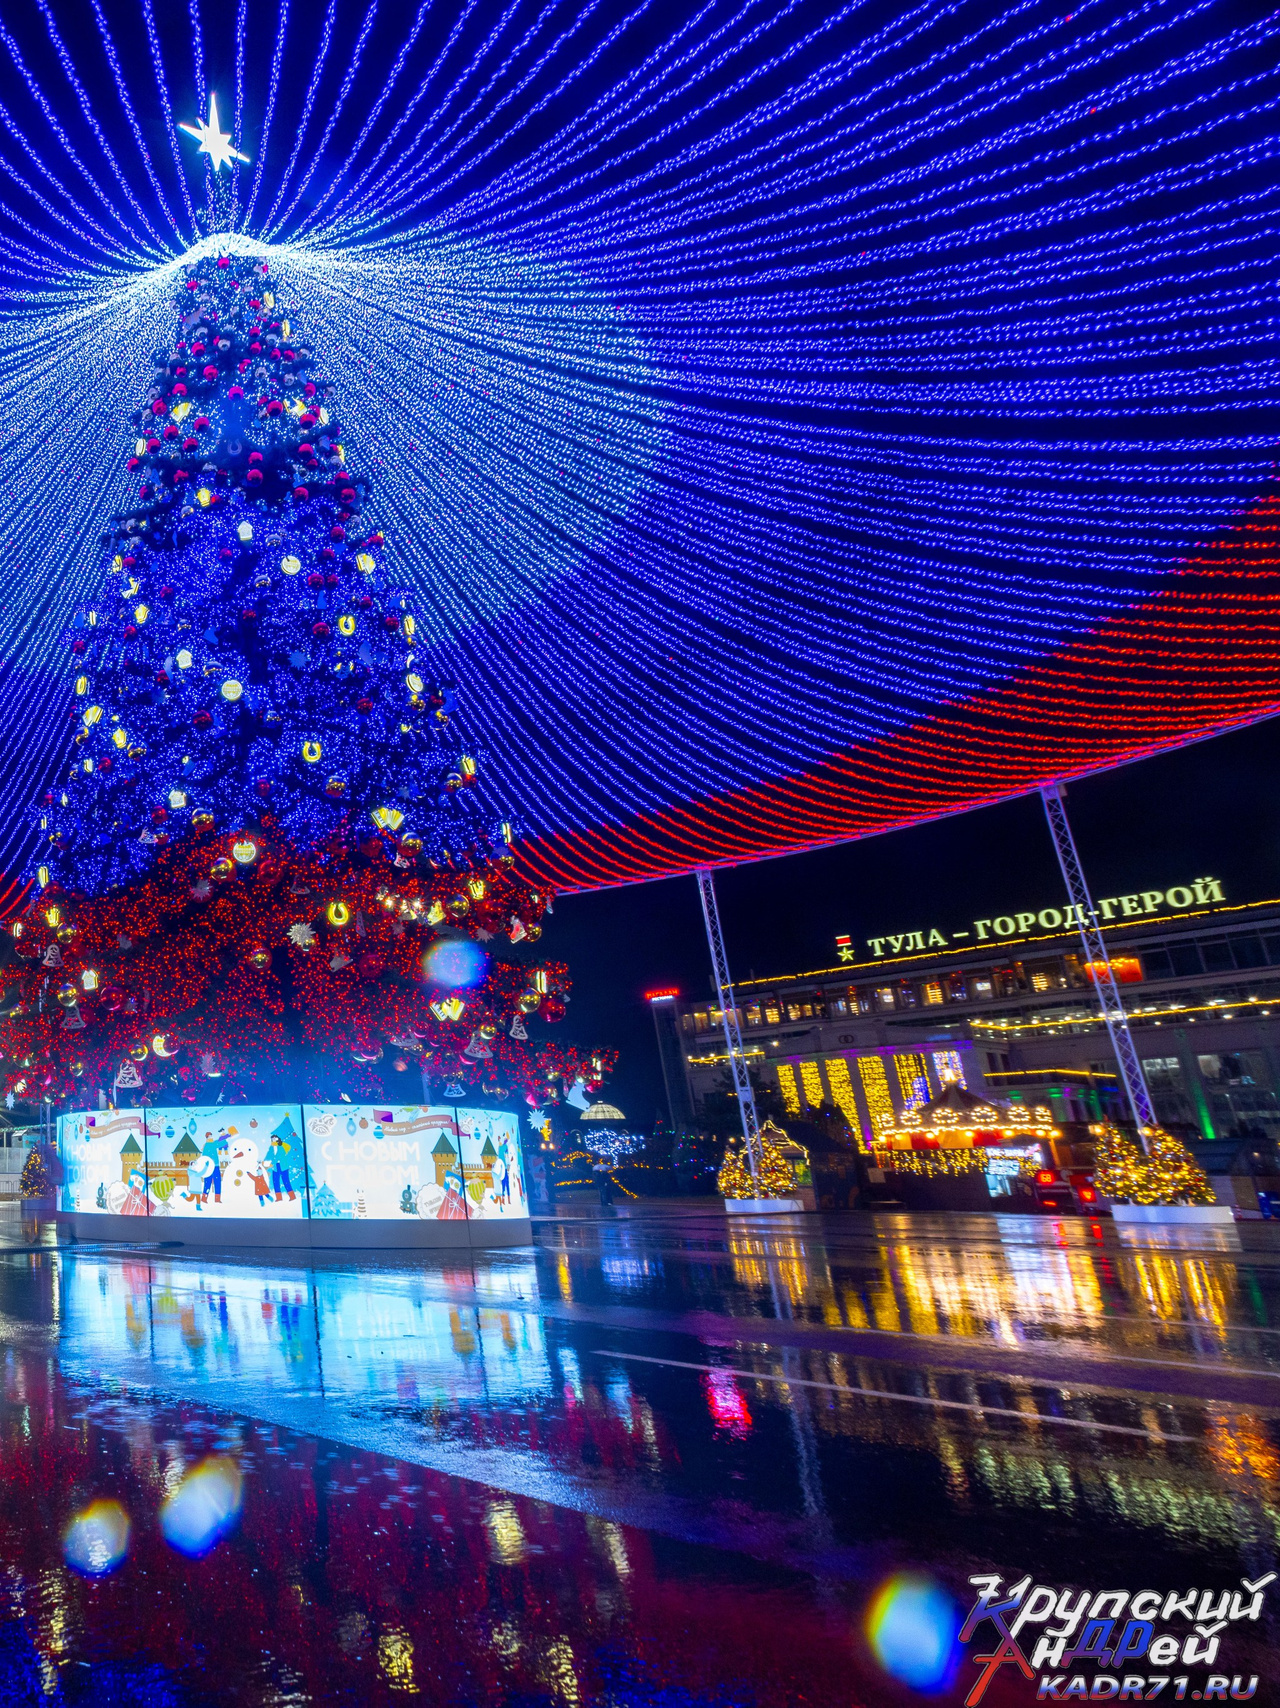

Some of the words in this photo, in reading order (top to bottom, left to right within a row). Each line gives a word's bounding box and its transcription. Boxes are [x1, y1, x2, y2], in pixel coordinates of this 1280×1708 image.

[867, 928, 949, 957] ТУЛА
[321, 1141, 333, 1161] С
[338, 1141, 421, 1162] НОВЫМ
[326, 1164, 420, 1186] ГОДОМ!
